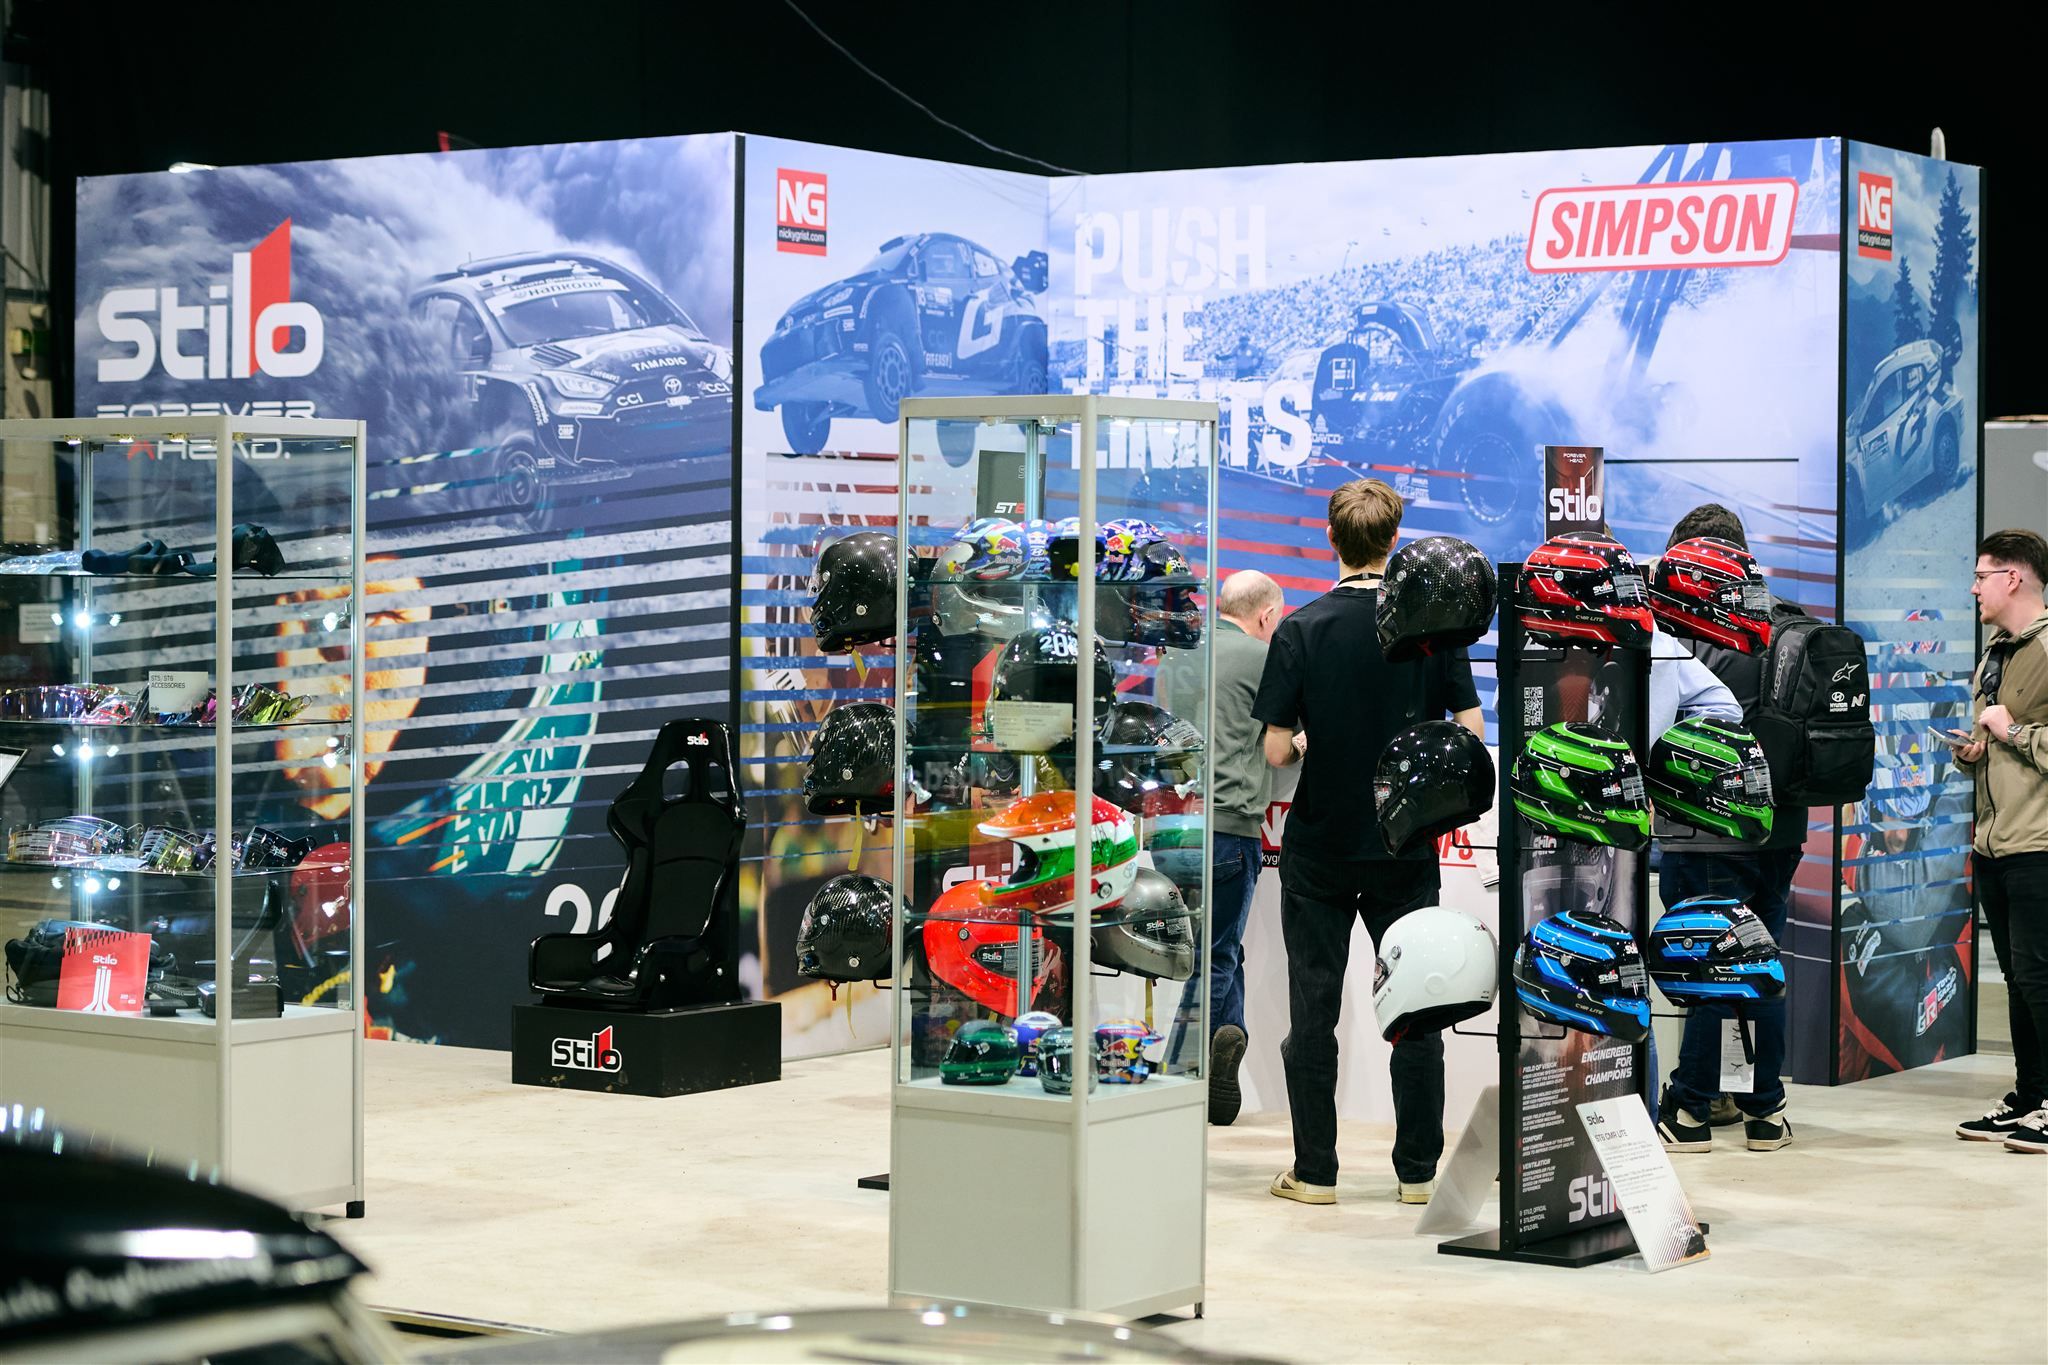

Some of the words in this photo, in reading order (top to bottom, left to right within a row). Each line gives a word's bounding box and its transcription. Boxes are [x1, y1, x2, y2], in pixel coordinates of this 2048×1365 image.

[779, 179, 825, 227] NG
[1860, 182, 1891, 230] NG
[779, 228, 825, 242] nickygrist.com
[1546, 193, 1777, 260] SIMPSON
[1075, 206, 1266, 295] PUSH
[97, 217, 324, 382] Stilo
[1075, 295, 1206, 381] THE
[620, 344, 681, 361] DENSO
[632, 357, 688, 371] TAMADIC
[616, 392, 644, 407] CCI
[1549, 476, 1601, 521] Stilo
[1593, 580, 1613, 594] Stilo
[1721, 588, 1741, 602] Stilo
[687, 731, 709, 746] Stilo
[1146, 919, 1165, 930] Stilo
[1717, 933, 1737, 951] Stilo
[92, 953, 118, 966] Stilo
[982, 951, 1002, 961] Stilo
[1599, 969, 1619, 982] Stilo
[552, 1026, 622, 1073] Stilo
[1581, 1045, 1632, 1063] ENGINEREED
[1615, 1056, 1632, 1068] FOR
[1585, 1067, 1632, 1085] CHAMPIONS
[1586, 1112, 1604, 1125] Stilo
[1568, 1171, 1624, 1223] Stil
